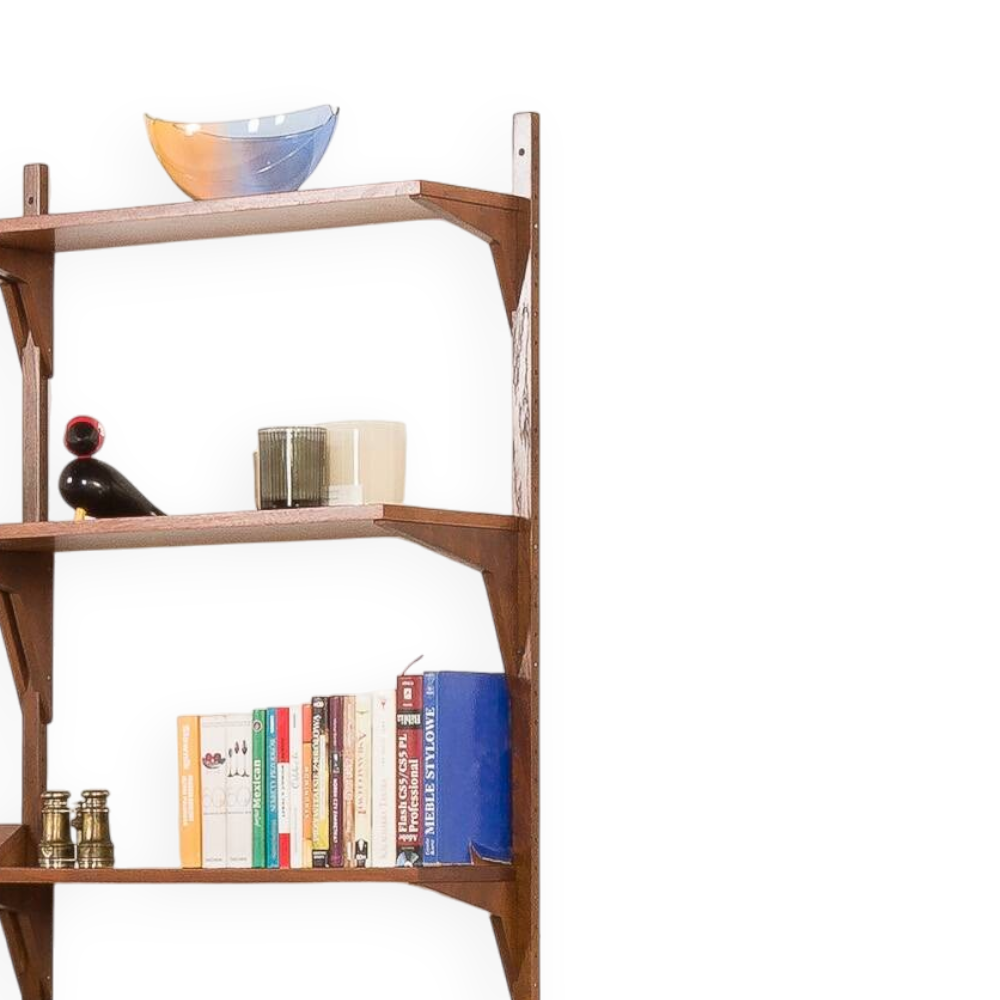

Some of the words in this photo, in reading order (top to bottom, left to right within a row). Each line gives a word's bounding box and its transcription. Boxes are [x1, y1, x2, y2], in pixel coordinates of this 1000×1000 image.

[398, 734, 408, 748] PL
[425, 707, 435, 780] STYLOWE
[252, 759, 262, 809] Mexican
[398, 749, 409, 801] CS5/CS5
[408, 759, 419, 833] Professional
[398, 803, 408, 833] Flash
[425, 783, 435, 836] MEBLE
